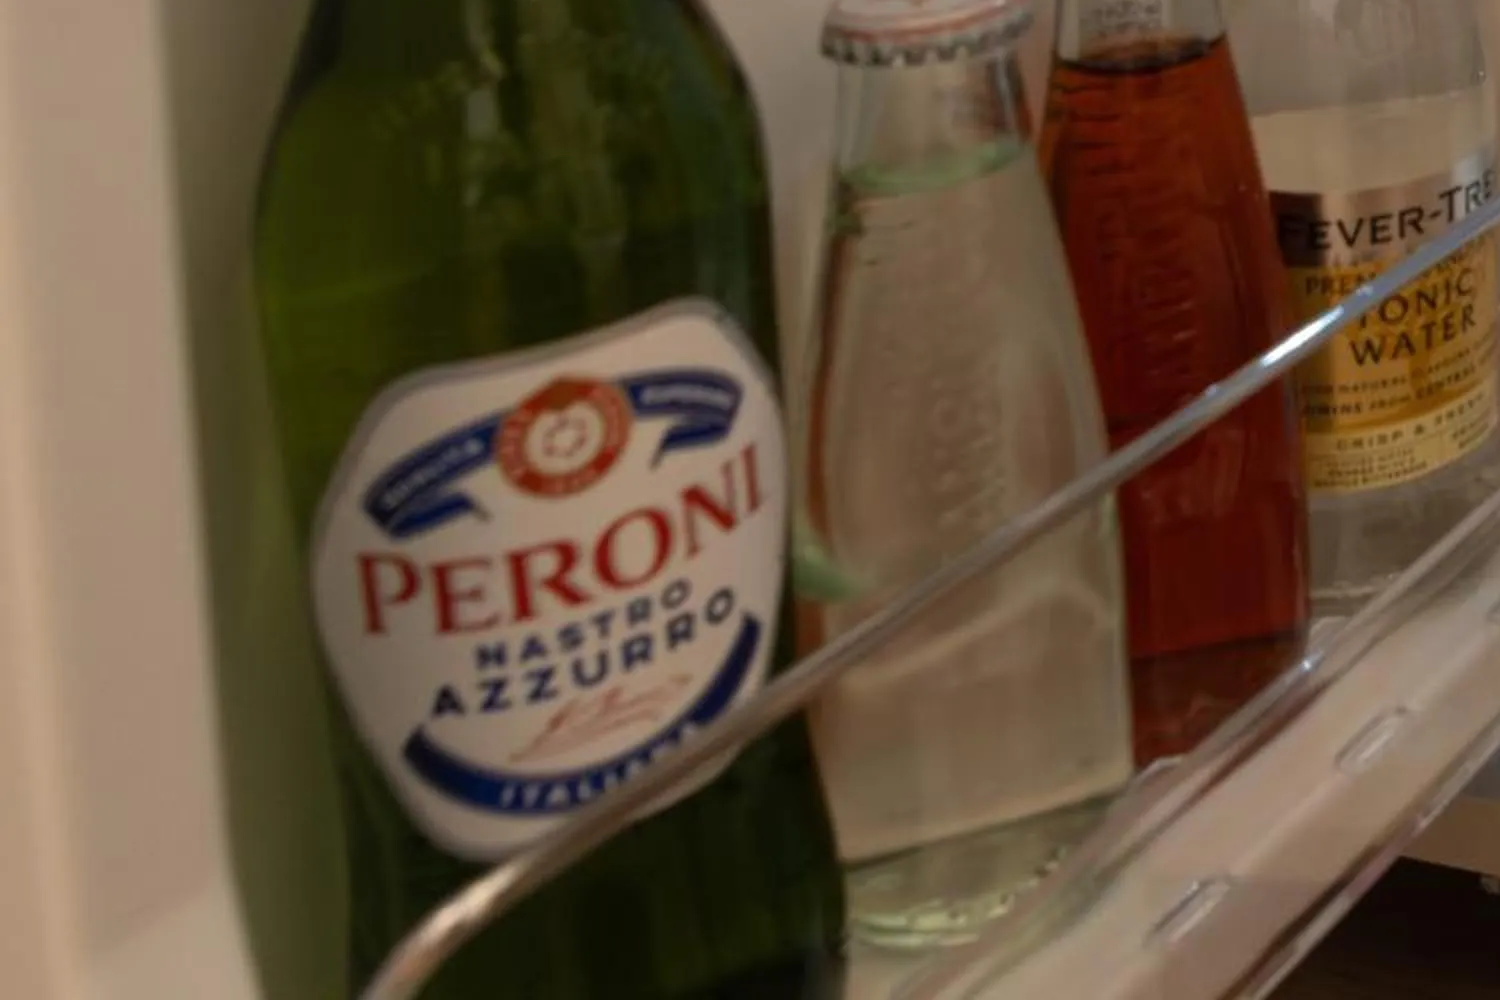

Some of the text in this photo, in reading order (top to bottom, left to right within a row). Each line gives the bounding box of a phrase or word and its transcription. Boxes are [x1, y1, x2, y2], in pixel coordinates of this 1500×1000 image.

[1350, 303, 1476, 367] WATER
[356, 441, 763, 635] PERONI
[431, 587, 736, 720] AZZURRO
[475, 578, 693, 671] NASTRO
